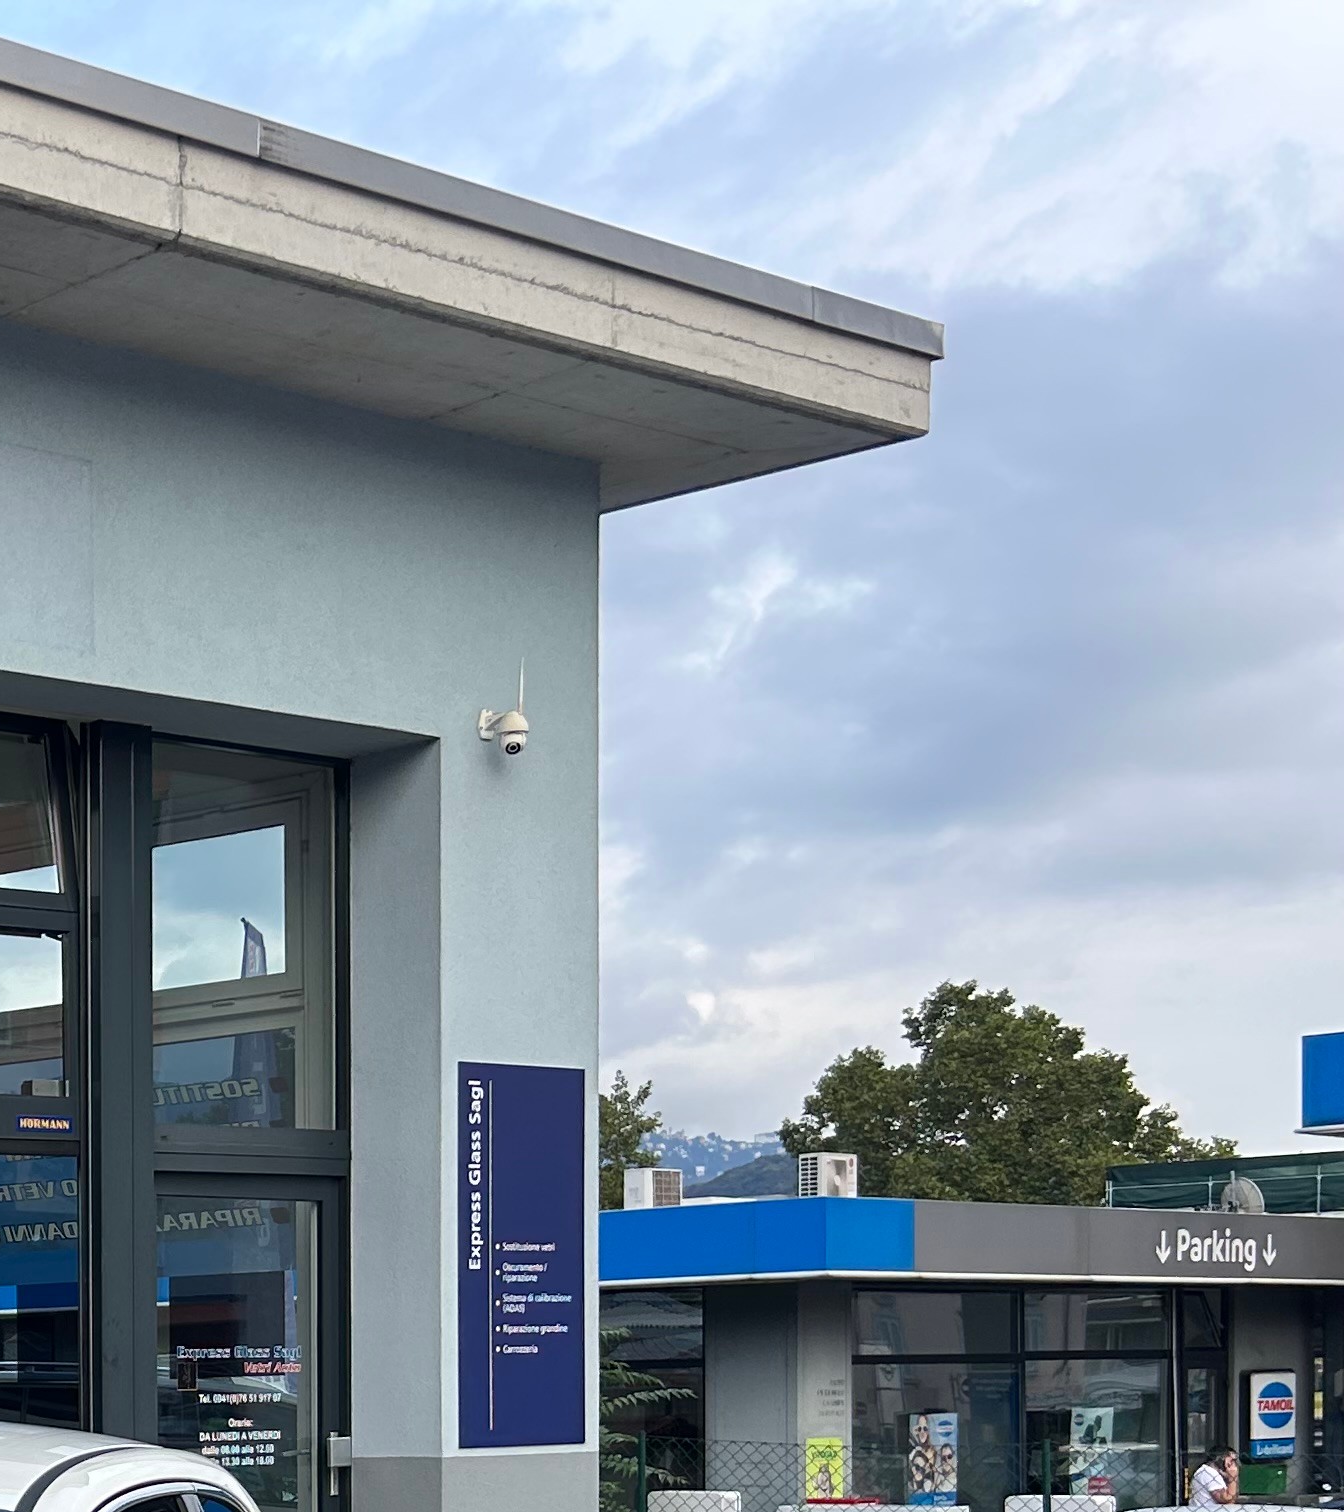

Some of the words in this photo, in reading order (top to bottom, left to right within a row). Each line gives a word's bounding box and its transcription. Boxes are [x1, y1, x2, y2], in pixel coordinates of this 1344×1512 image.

[468, 1080, 483, 1125] Sagl
[468, 1131, 481, 1185] Glass
[468, 1191, 483, 1270] Express
[1177, 1228, 1257, 1272] Parking
[176, 1345, 231, 1361] Express
[234, 1345, 271, 1359] Glass
[1257, 1399, 1294, 1411] TAMOIL
[241, 1431, 248, 1441] A
